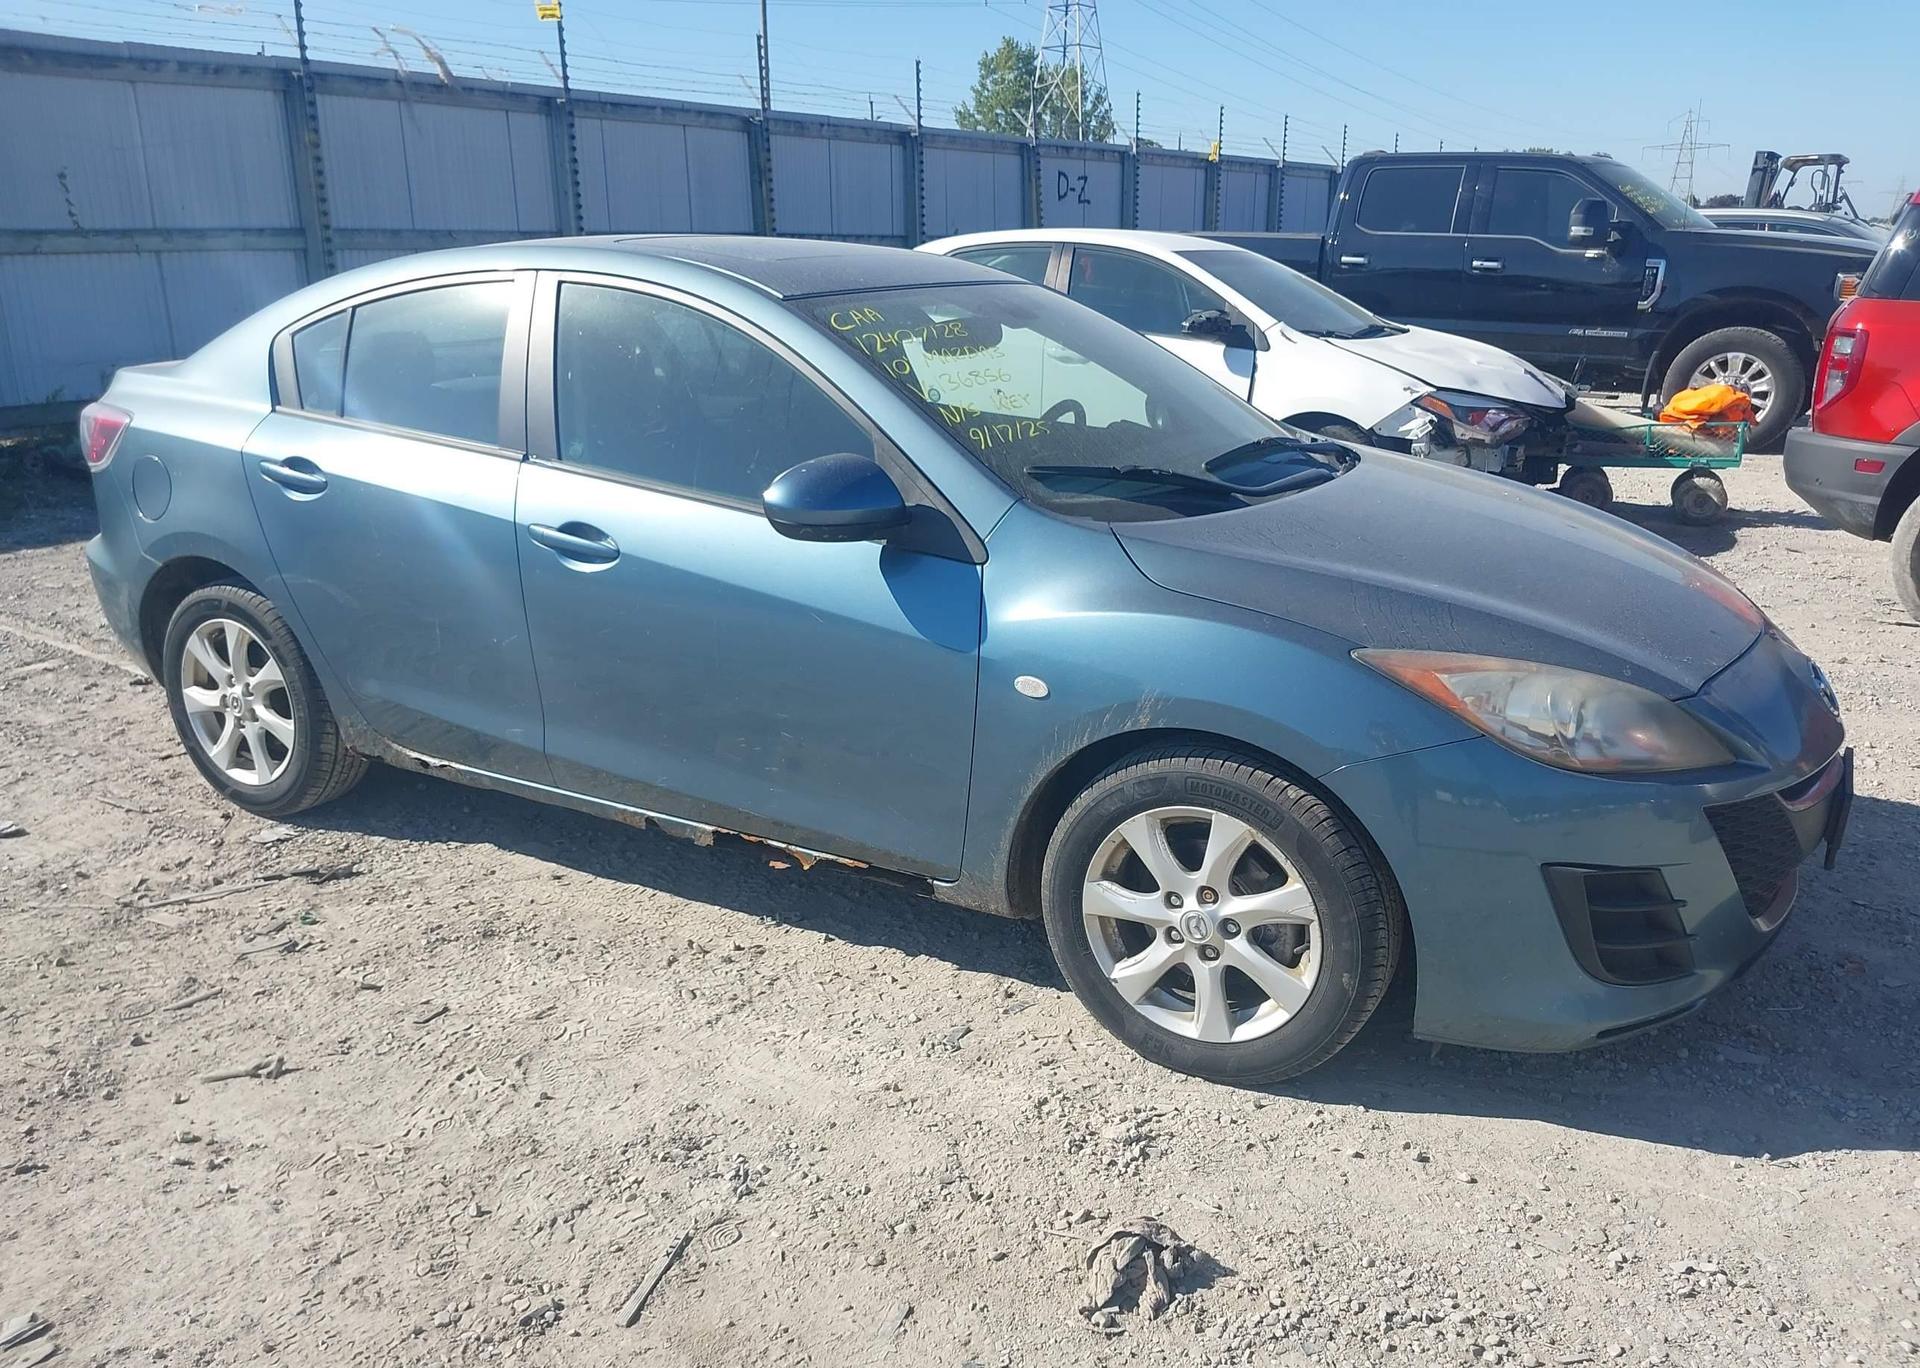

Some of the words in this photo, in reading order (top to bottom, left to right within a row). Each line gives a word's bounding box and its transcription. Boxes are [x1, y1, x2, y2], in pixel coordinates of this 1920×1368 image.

[831, 307, 886, 331] CAA
[855, 321, 969, 356] 12407128
[969, 419, 1050, 450] 9/17/25
[1189, 780, 1271, 820] MOTOMASTER
